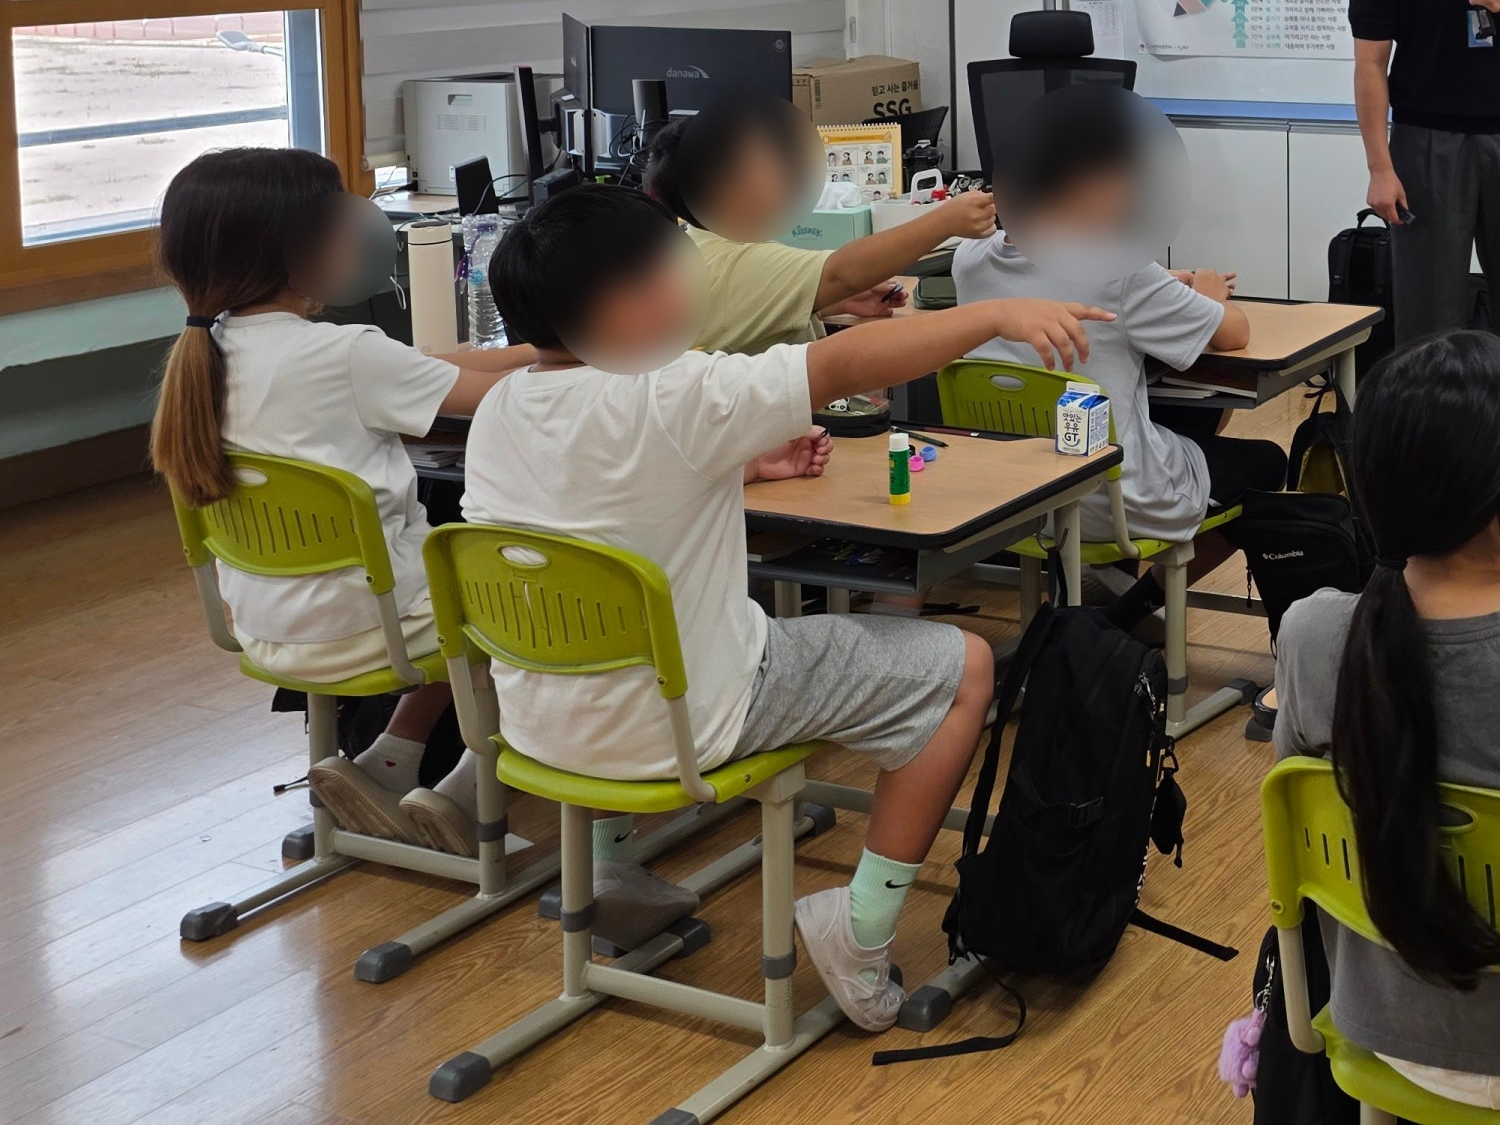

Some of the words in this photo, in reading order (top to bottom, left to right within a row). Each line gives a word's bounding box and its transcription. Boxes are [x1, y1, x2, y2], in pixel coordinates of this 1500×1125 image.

[666, 67, 700, 79] danawa
[872, 85, 885, 96] 믿고
[887, 83, 900, 93] 사는
[873, 98, 912, 117] SSG
[1063, 413, 1082, 423] 맛있는
[1064, 422, 1080, 433] 우유
[1064, 432, 1079, 442] GT
[1269, 550, 1304, 560] Columbia
